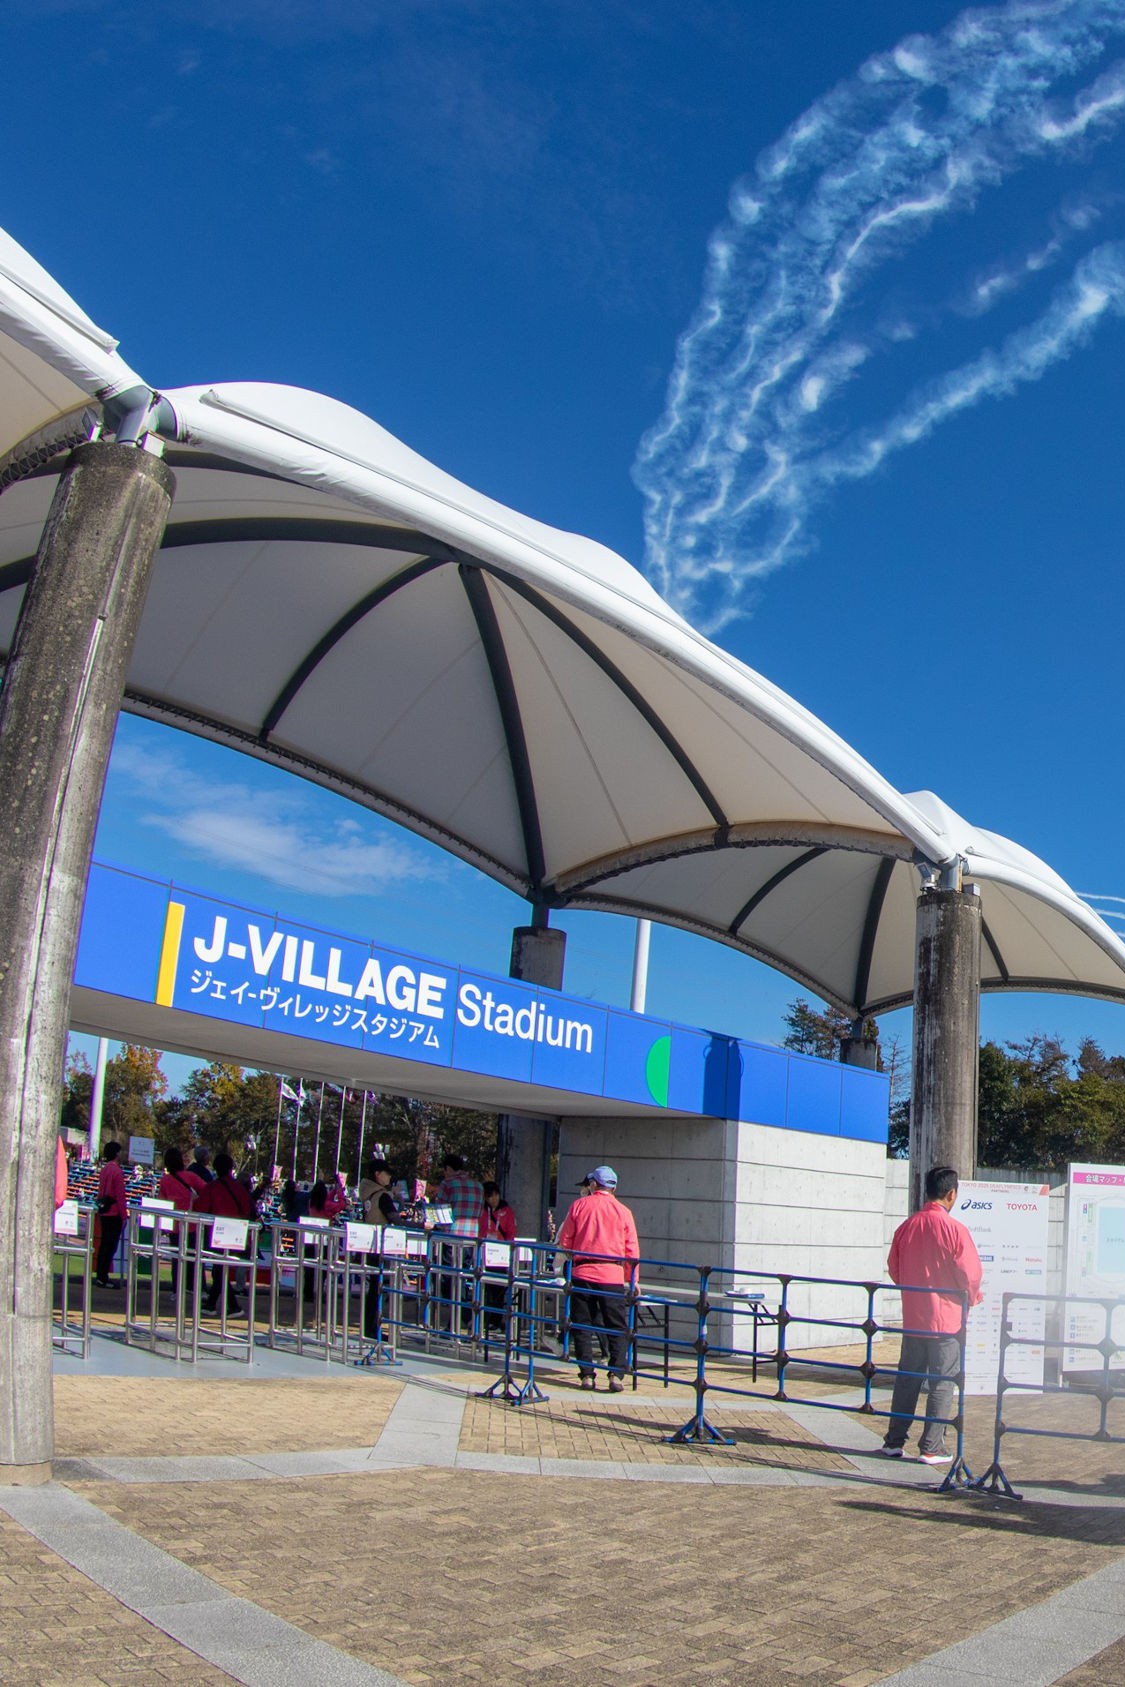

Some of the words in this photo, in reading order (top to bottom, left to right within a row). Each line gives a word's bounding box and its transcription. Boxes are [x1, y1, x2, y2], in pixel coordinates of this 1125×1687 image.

[193, 915, 447, 1020] J-VILLAGE
[456, 983, 593, 1054] Stadium
[1007, 1203, 1038, 1211] TOYOTA
